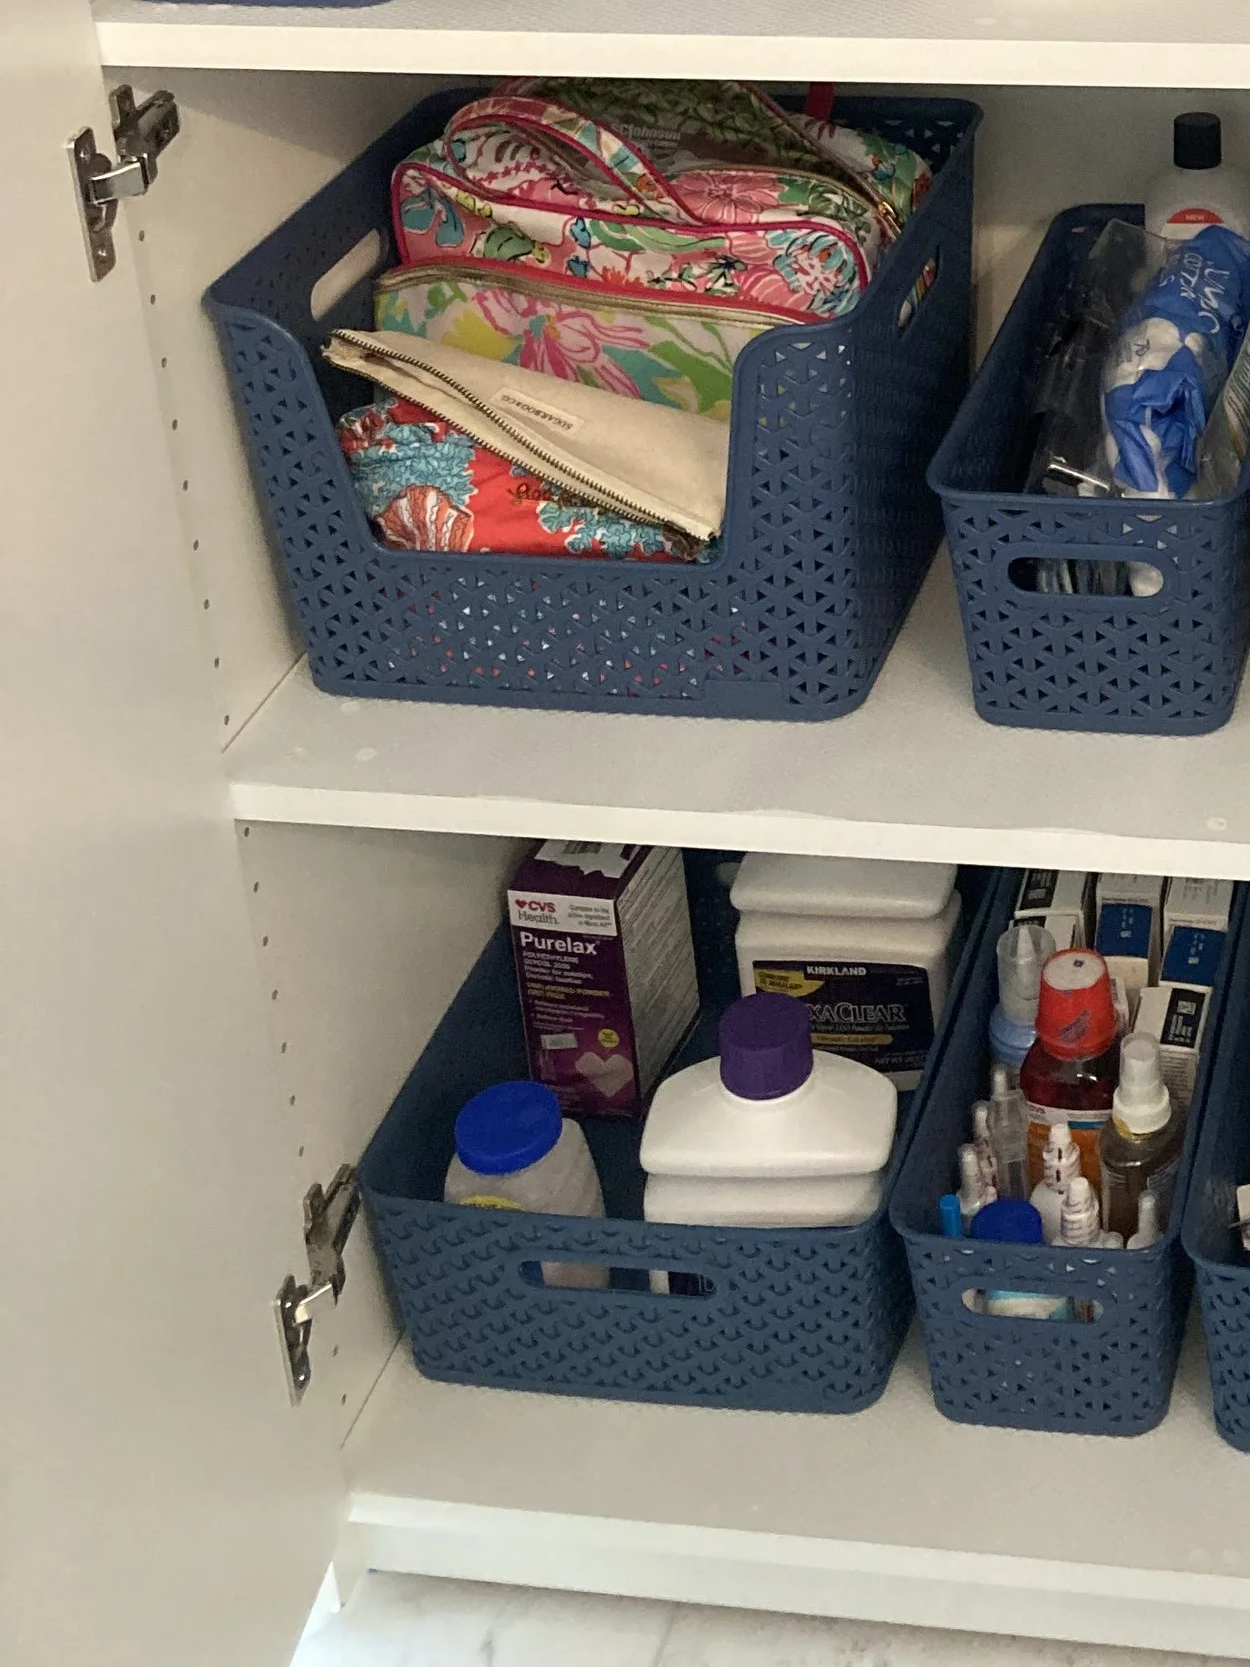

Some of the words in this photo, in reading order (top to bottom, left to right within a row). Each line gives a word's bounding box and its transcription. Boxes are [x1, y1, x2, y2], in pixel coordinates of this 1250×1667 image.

[528, 900, 557, 913] CVS
[519, 931, 598, 956] Purelax
[806, 965, 867, 976] KIRKLAND
[808, 1001, 907, 1024] XACLEAR
